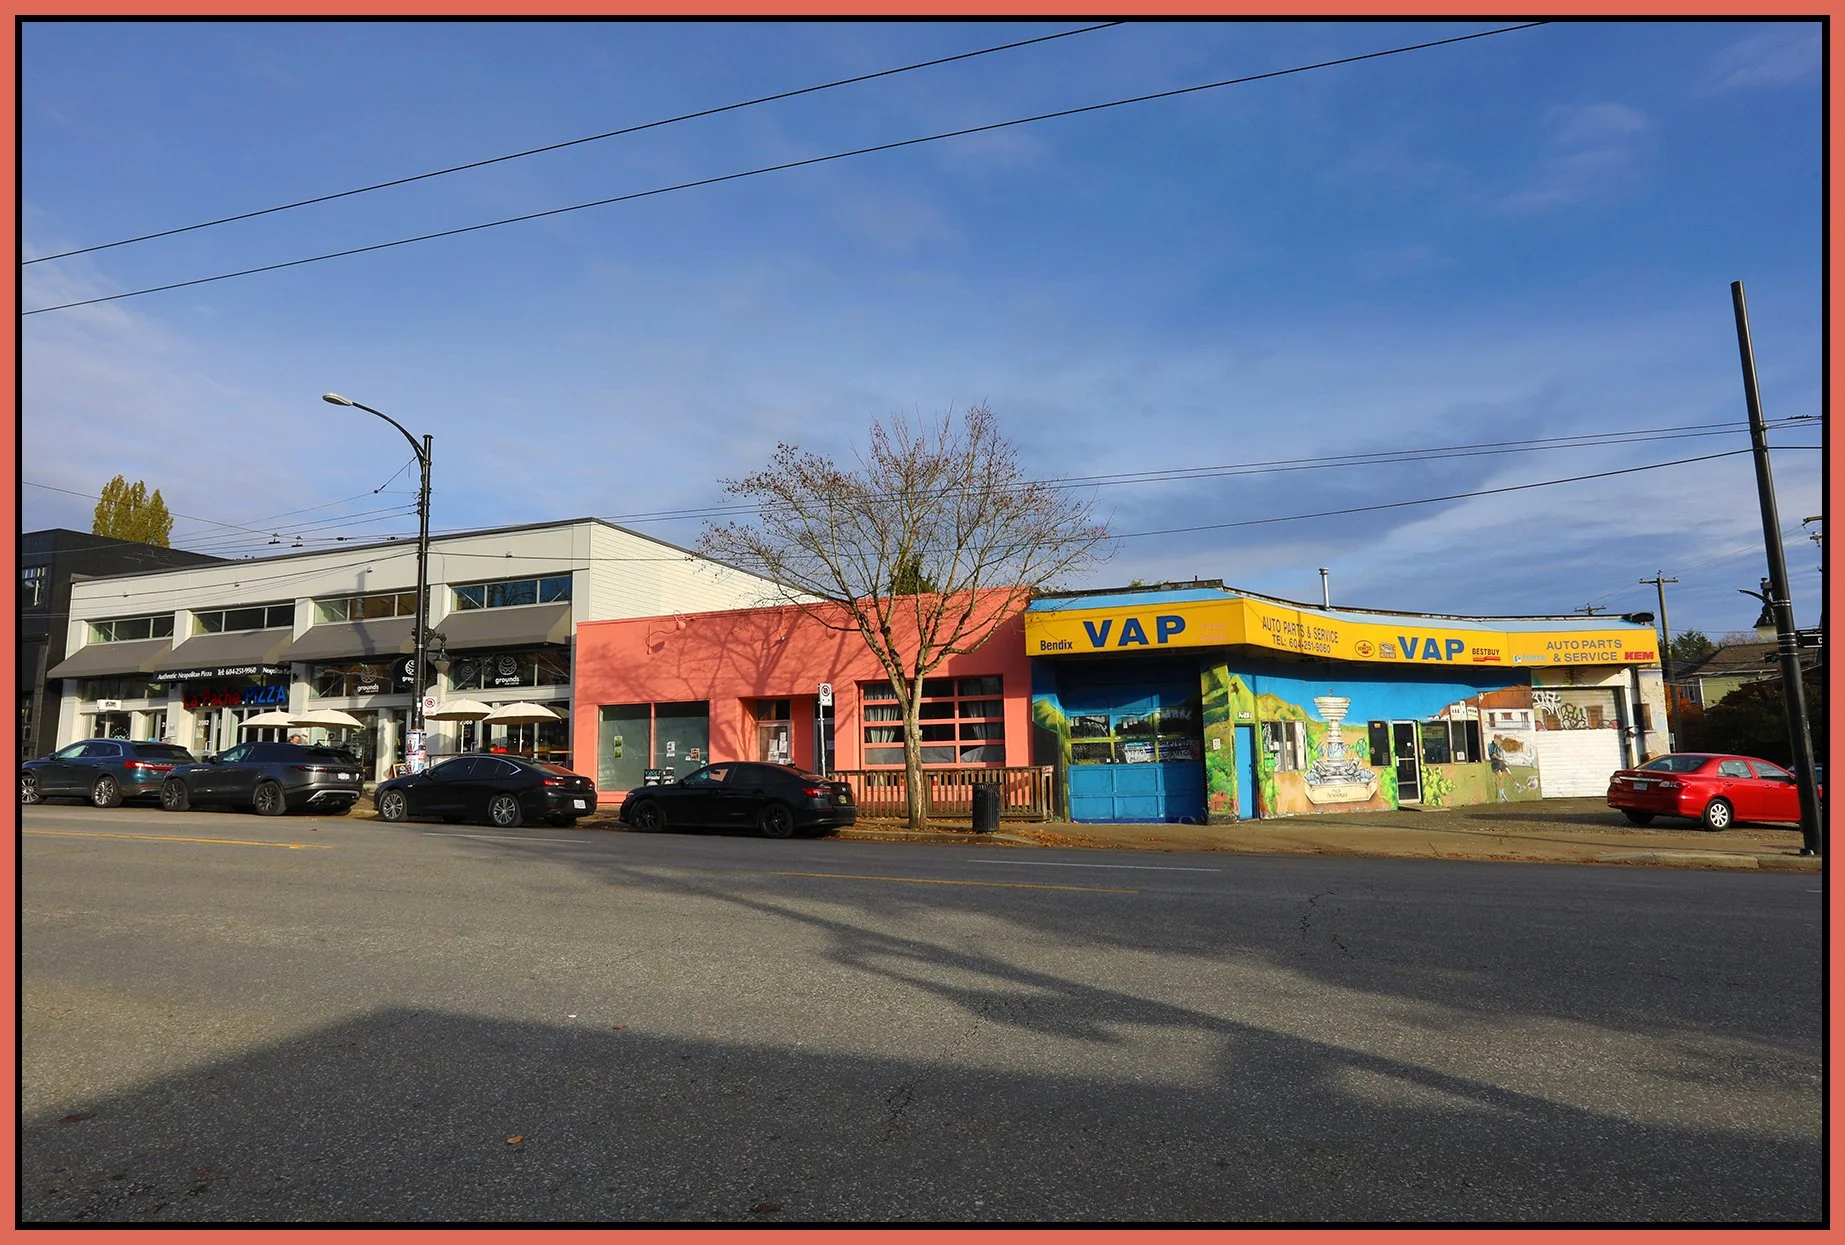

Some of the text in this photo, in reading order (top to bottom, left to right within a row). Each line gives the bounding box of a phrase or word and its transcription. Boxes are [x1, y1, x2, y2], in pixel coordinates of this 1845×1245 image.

[1082, 615, 1186, 648] VAP
[1262, 616, 1339, 644] AUTO PARTS & SERVICE
[1040, 639, 1073, 651] Bendix
[1272, 634, 1287, 646] TEL:
[1546, 639, 1622, 650] AUTO PARTS
[1397, 636, 1465, 661] VAP
[1553, 653, 1561, 662] &
[1564, 652, 1618, 662] SERVICE
[1624, 651, 1654, 661] KEM
[200, 670, 213, 678] Pizza
[494, 675, 520, 685] grounds
[356, 683, 380, 693] grounds
